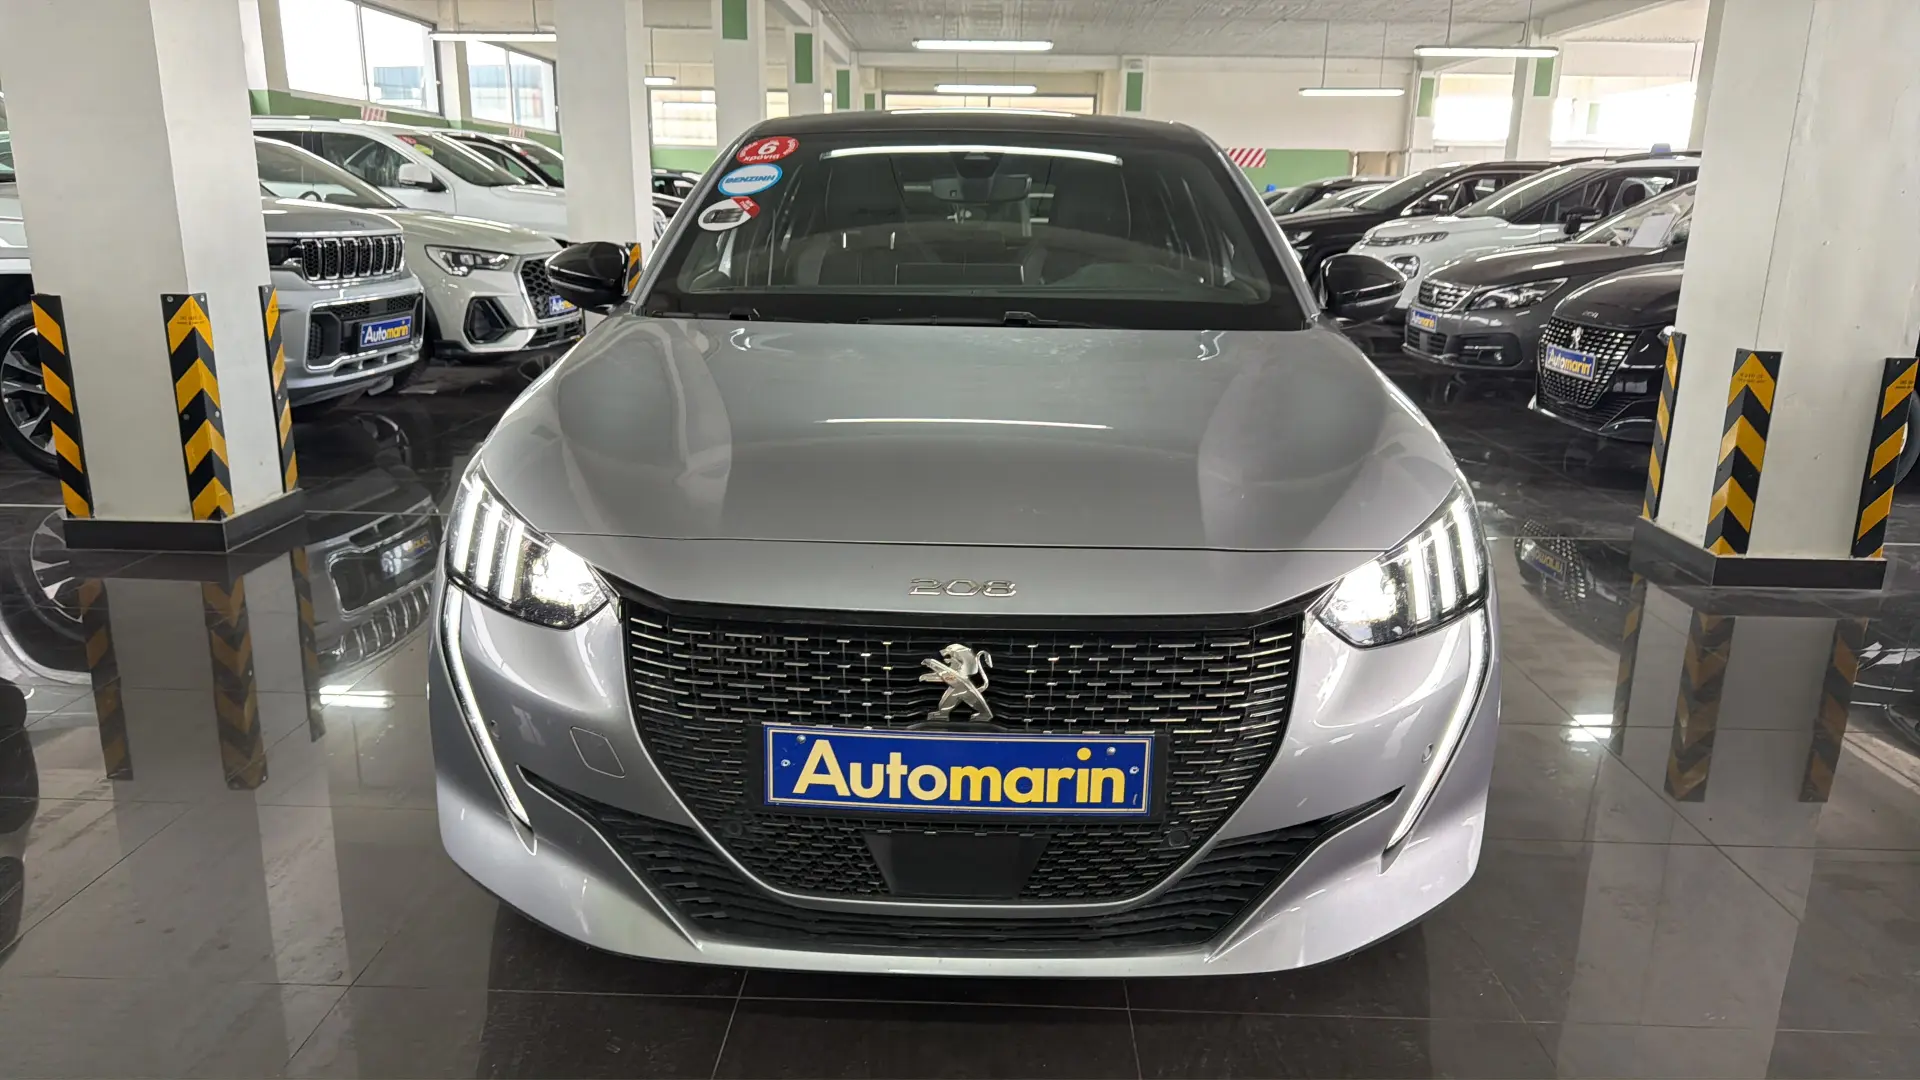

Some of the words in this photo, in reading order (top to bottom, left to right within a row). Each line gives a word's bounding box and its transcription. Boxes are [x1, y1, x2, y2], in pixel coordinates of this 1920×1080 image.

[758, 140, 780, 155] 6
[364, 321, 409, 344] Automarin
[1548, 348, 1592, 375] Automarin
[908, 578, 1017, 597] 208
[792, 739, 1125, 804] Automarin
